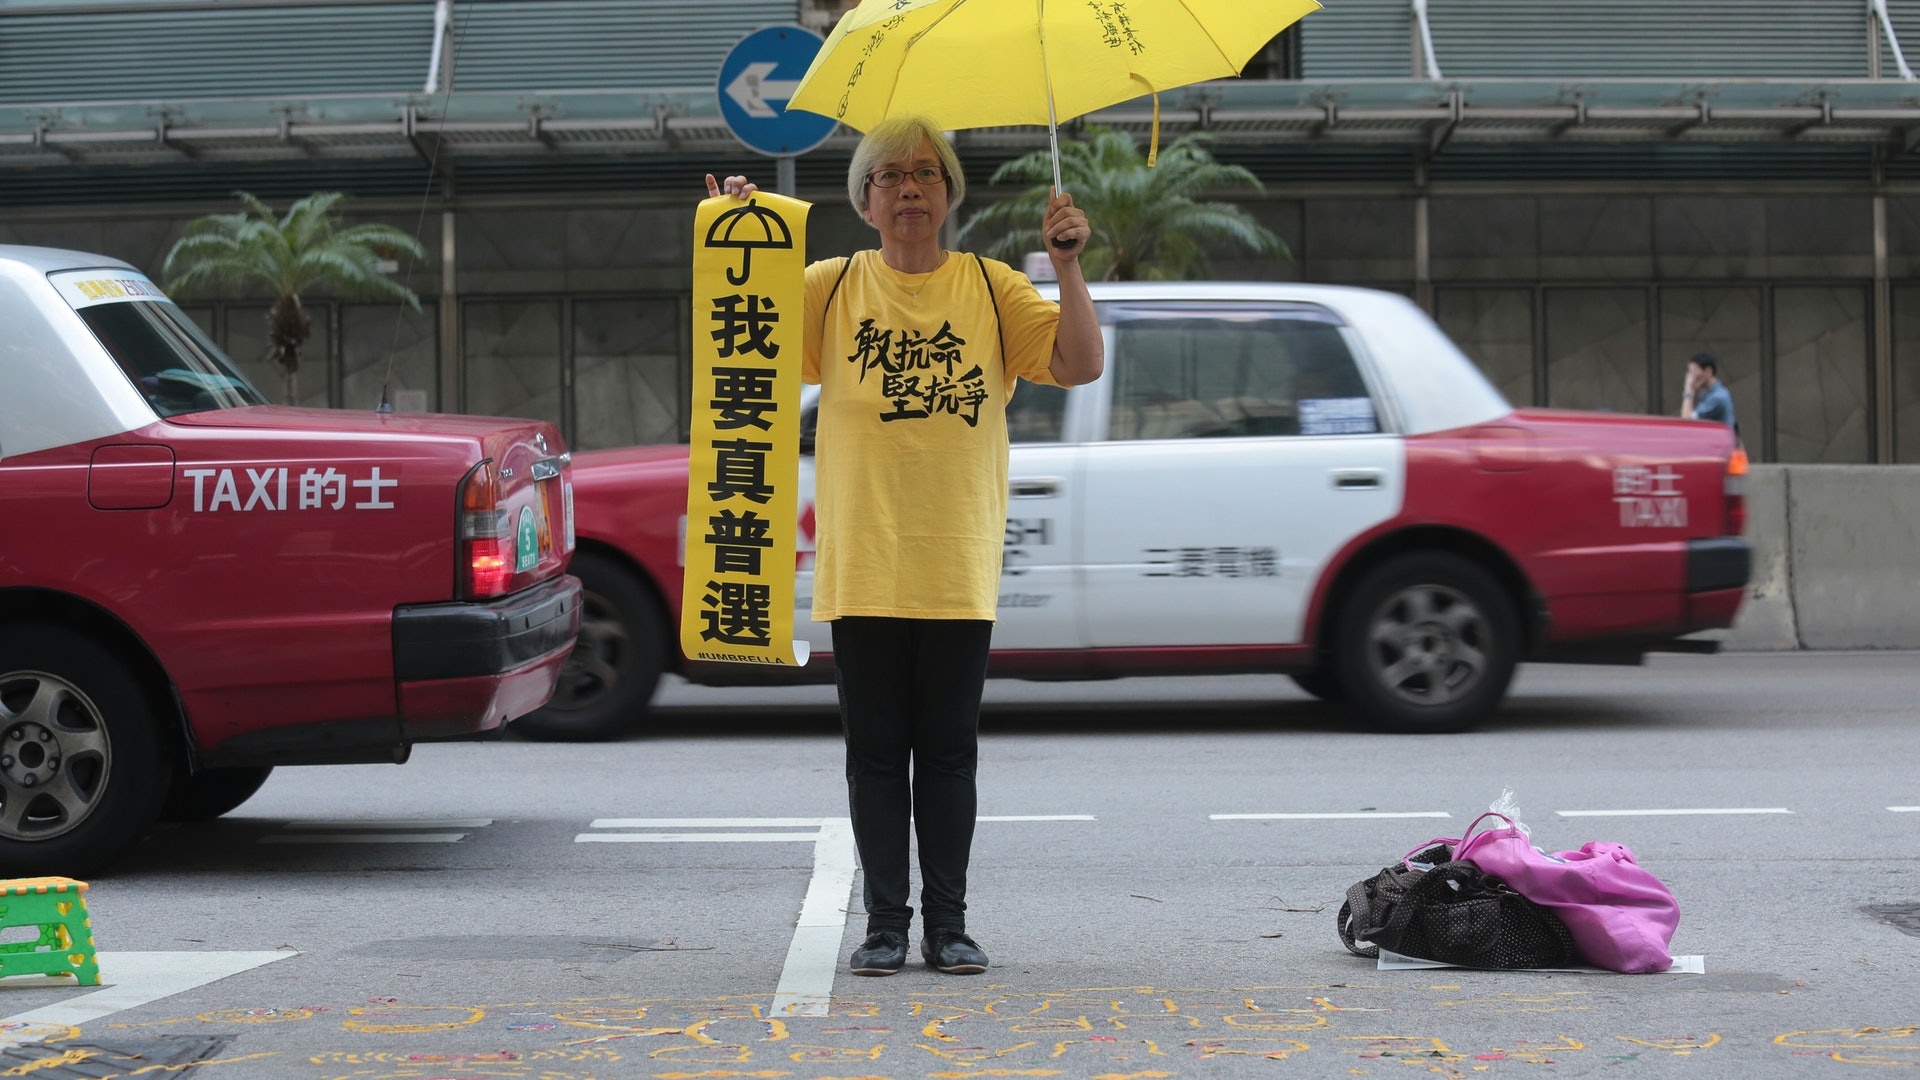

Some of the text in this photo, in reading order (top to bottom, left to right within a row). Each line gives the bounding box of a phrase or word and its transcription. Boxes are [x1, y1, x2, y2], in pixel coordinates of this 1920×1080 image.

[847, 318, 966, 385] 敢抗命
[879, 364, 989, 428] 堅抗爭
[700, 294, 780, 647] 我要真普選
[1612, 464, 1684, 496] 的士
[183, 467, 288, 512] TAXI
[299, 466, 398, 510] 的士
[1611, 496, 1688, 528] TAXI
[525, 527, 531, 551] 5
[521, 552, 536, 568] SEATS
[1142, 546, 1281, 578] 三菱電機
[697, 651, 786, 665] #UMBRELLA
